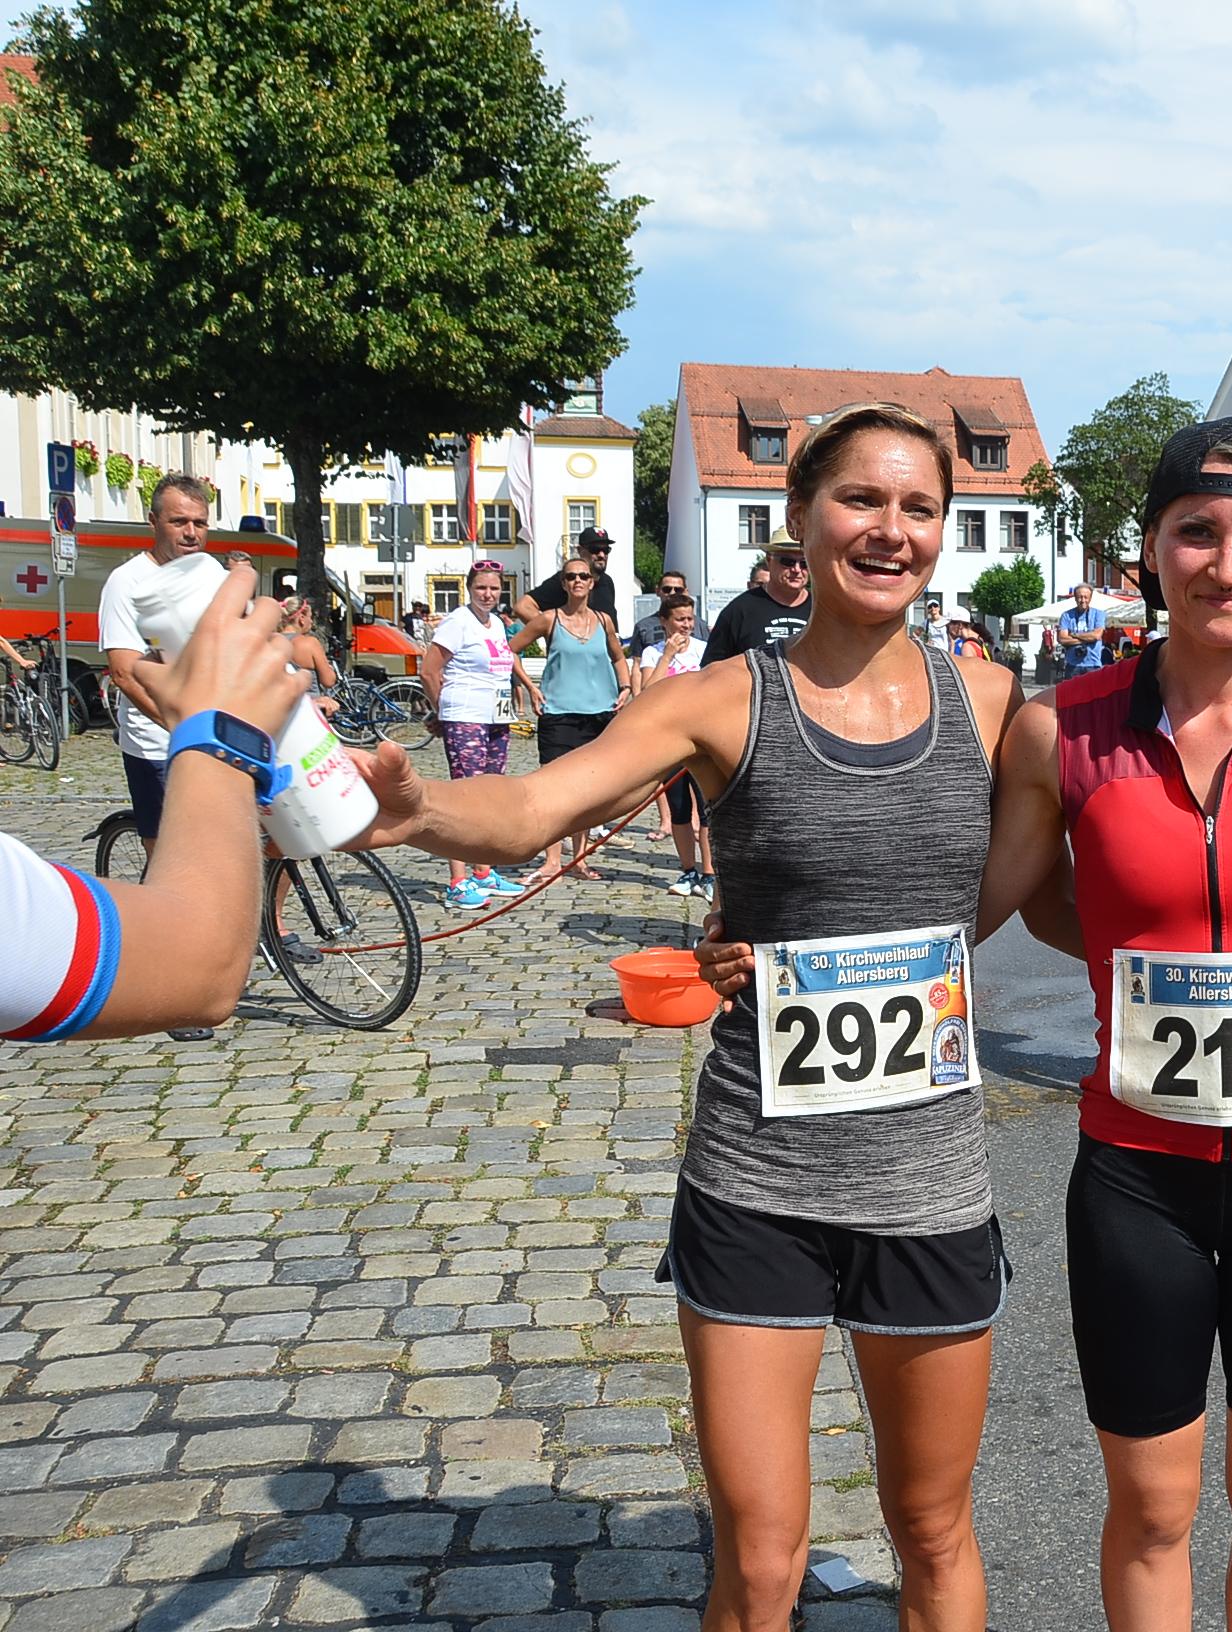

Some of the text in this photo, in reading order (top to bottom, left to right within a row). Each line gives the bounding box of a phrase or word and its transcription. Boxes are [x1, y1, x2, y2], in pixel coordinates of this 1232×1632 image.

[53, 450, 69, 485] P
[810, 943, 931, 970] 30. Kirchweihlauf
[837, 966, 909, 985] Allersberg
[1165, 968, 1185, 983] 30.
[775, 995, 926, 1087] 292
